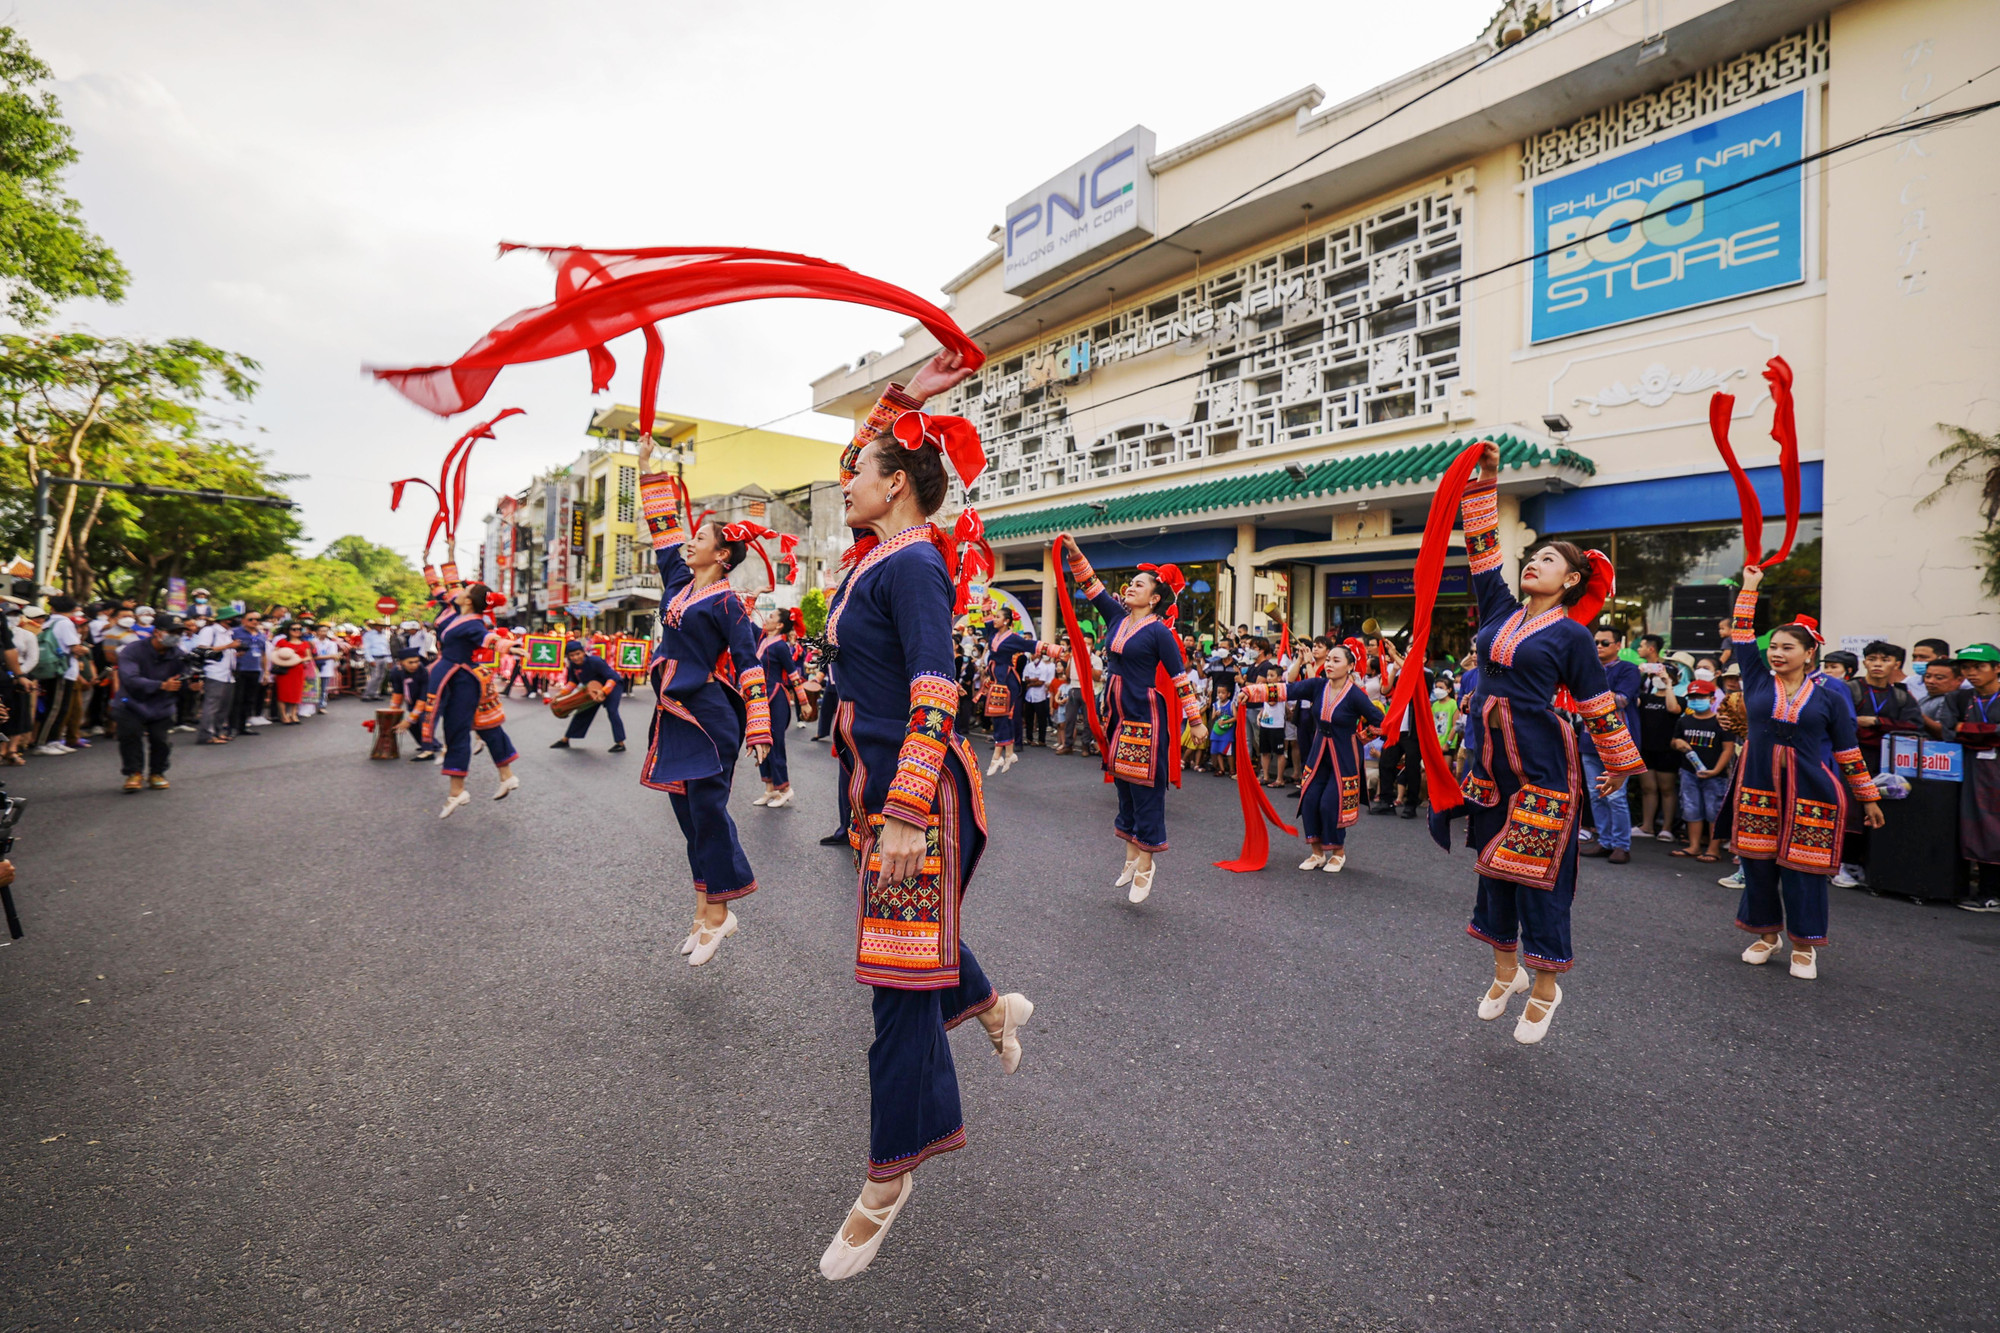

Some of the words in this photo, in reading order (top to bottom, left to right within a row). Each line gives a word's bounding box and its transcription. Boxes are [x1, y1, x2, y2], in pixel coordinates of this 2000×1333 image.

[1696, 130, 1781, 173] NAM
[1006, 145, 1134, 258] PNC
[1060, 222, 1088, 247] NAM
[1093, 199, 1134, 229] CORP
[1547, 221, 1780, 313] STORE
[1226, 277, 1304, 321] NAM
